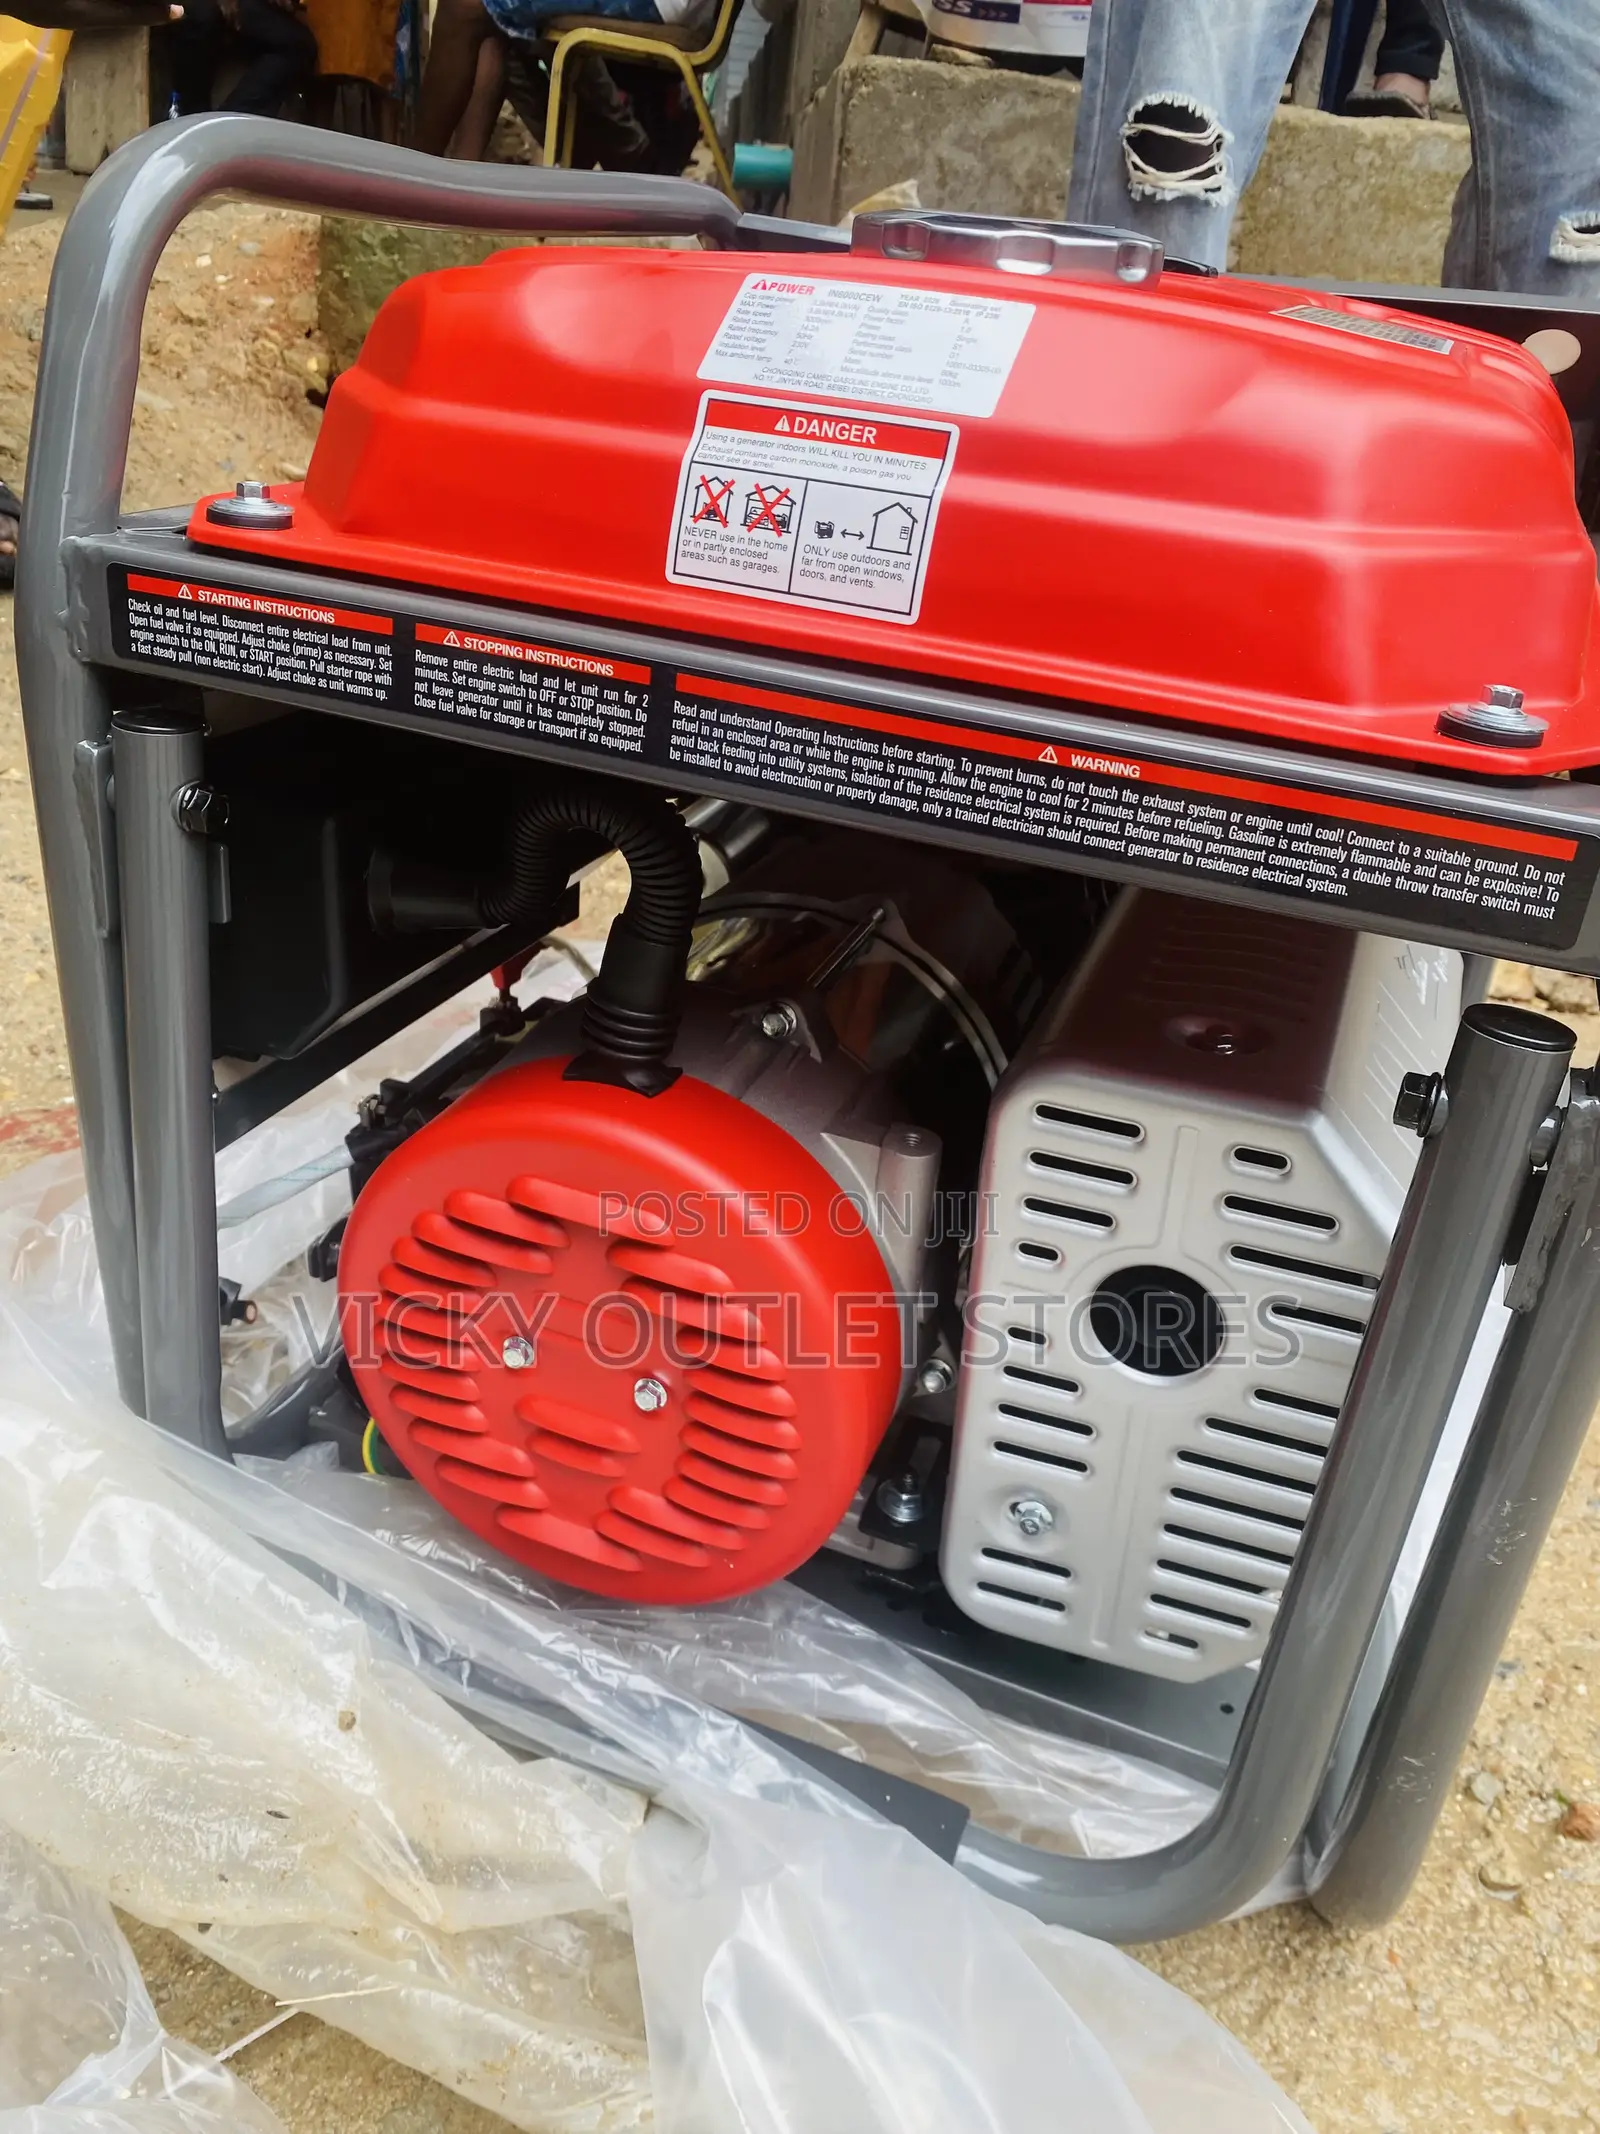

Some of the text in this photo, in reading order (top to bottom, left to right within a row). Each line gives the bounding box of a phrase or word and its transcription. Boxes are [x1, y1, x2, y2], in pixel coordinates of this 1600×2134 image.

[793, 416, 876, 444] DANGER
[700, 443, 732, 454] Exhaust
[733, 449, 766, 460] contains
[768, 455, 796, 464] carbon
[797, 459, 836, 471] monoxide,
[848, 466, 876, 475] poison
[895, 472, 911, 480] you
[704, 431, 728, 444] Using
[736, 437, 775, 448] generator
[775, 440, 806, 452] indoors
[808, 445, 829, 456] WILL
[830, 448, 849, 459] KILL
[851, 451, 871, 462] YOU
[873, 454, 883, 464] IN
[884, 456, 926, 470] MINUTES
[682, 538, 768, 559] or in partly enclosed
[684, 526, 787, 551] NEVER use in the home
[680, 550, 779, 573] areas such as garages.
[800, 556, 904, 582] far from open windows,
[802, 545, 910, 570] ONLY use outdoors and
[799, 568, 874, 588] doors, and vents.
[198, 591, 334, 623] STARTING INSTRUCTIONS
[128, 598, 391, 655] Check oil and fuel level. Disconnect entire electrical load from unit.
[130, 629, 391, 685] engine switch to the ON, RUN, or START position. Pull starter rope with
[463, 637, 613, 676] STOPPING INSTRUCTIONS
[415, 650, 647, 707] Remove entire electric load and let unit run for 2
[415, 665, 646, 722] minutes. Set engine switch to OFF or STOP position. Do
[1071, 754, 1139, 778] WARNING
[673, 701, 1565, 885] Read and understand Operating Instructions before starting. To prevent burns, do not touch the exhaust system or engine until cool! Connect to a suitable ground. Do not
